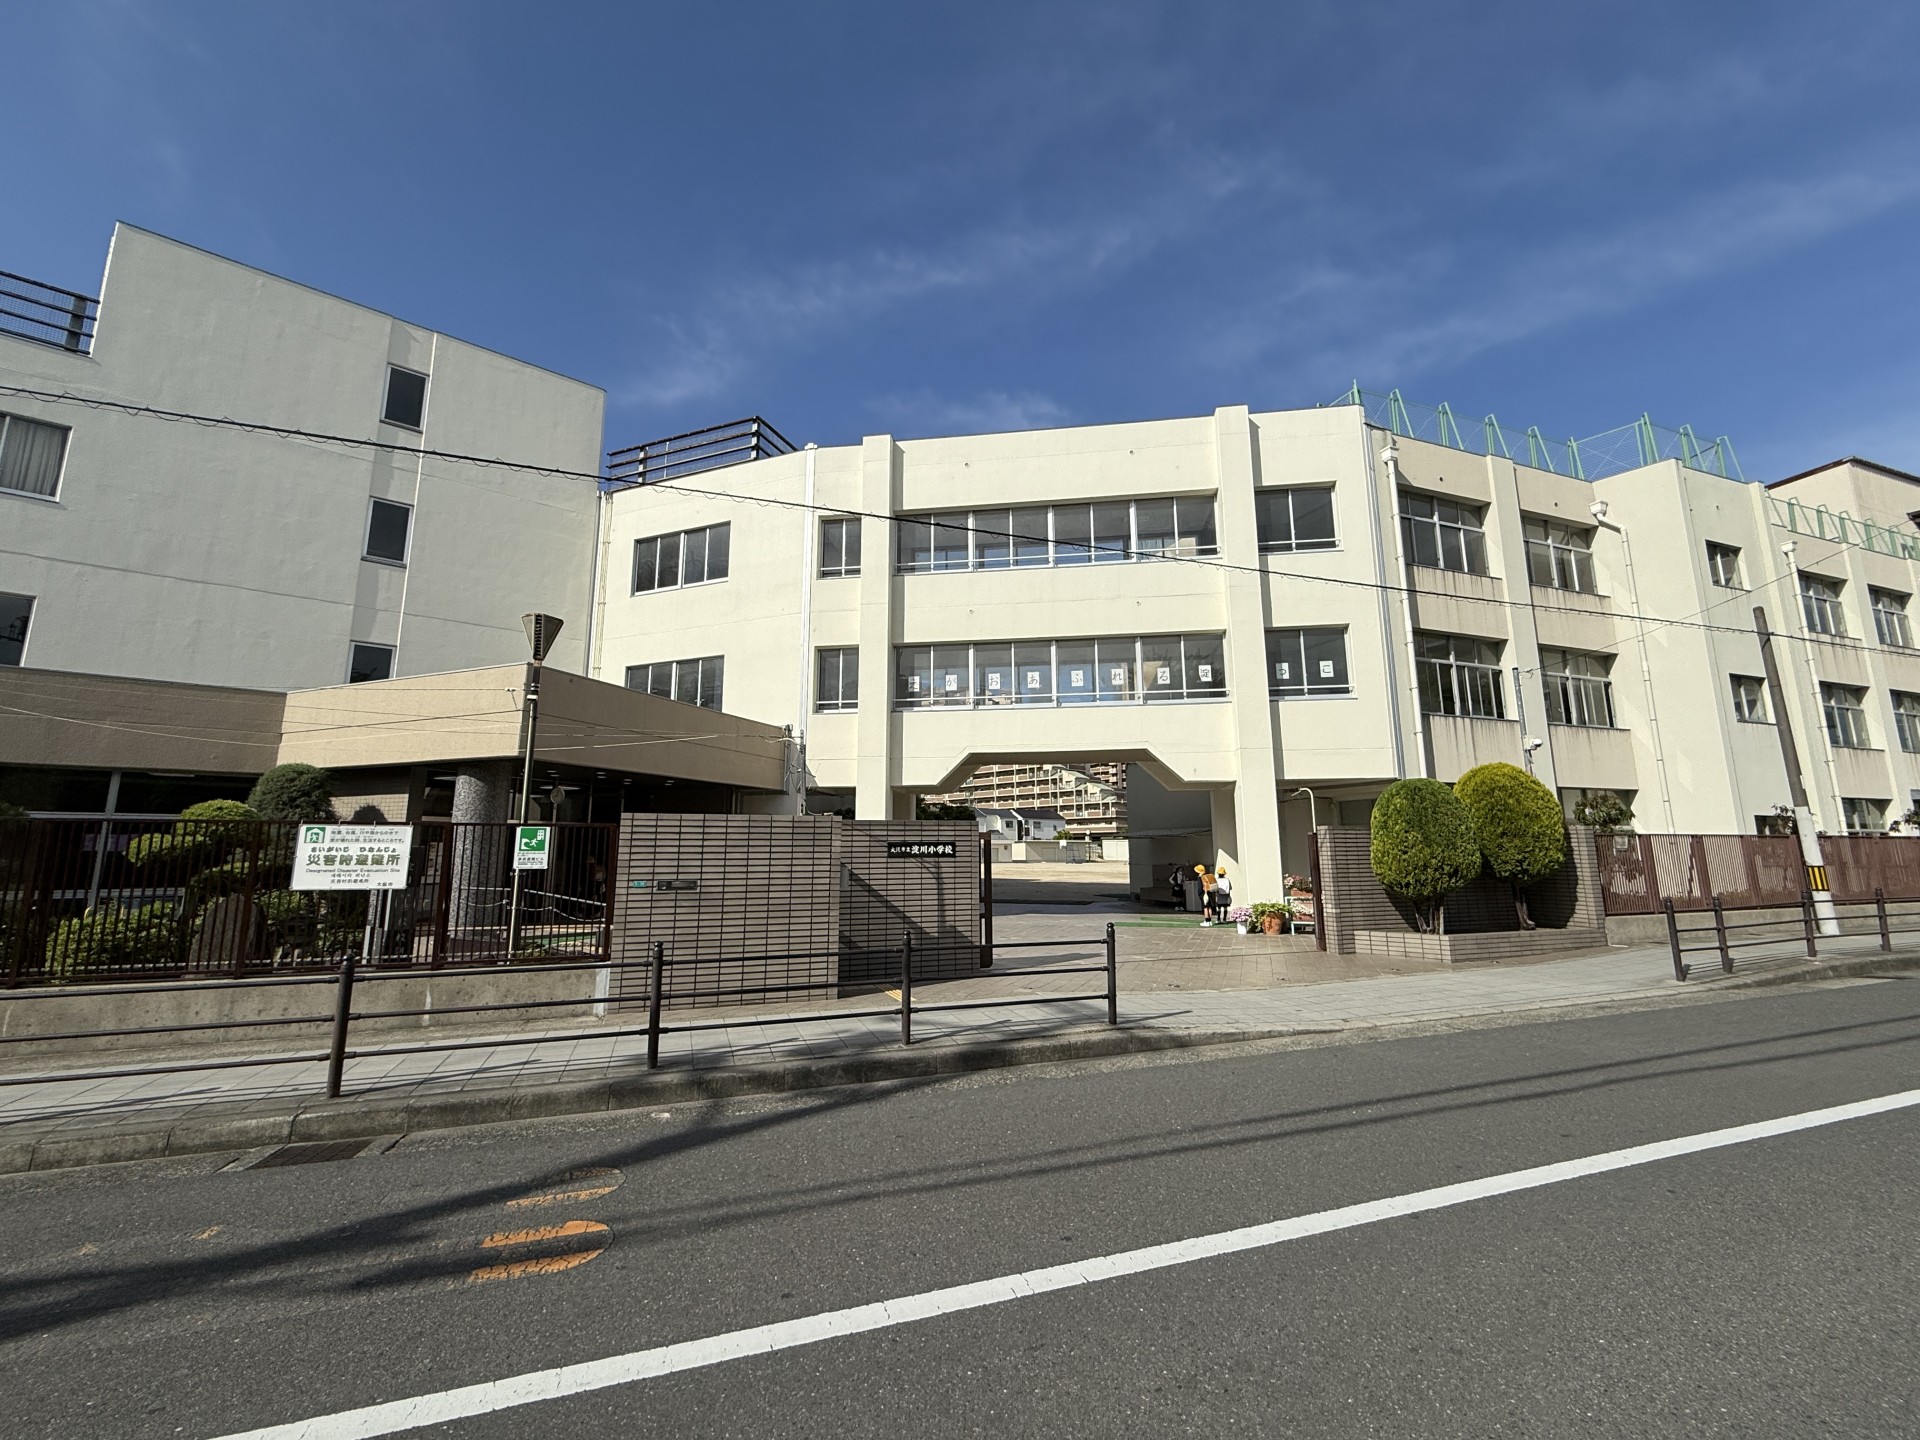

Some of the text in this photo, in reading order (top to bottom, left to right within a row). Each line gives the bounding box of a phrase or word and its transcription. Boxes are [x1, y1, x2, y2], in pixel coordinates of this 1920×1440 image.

[306, 854, 401, 866] 災害時避難所
